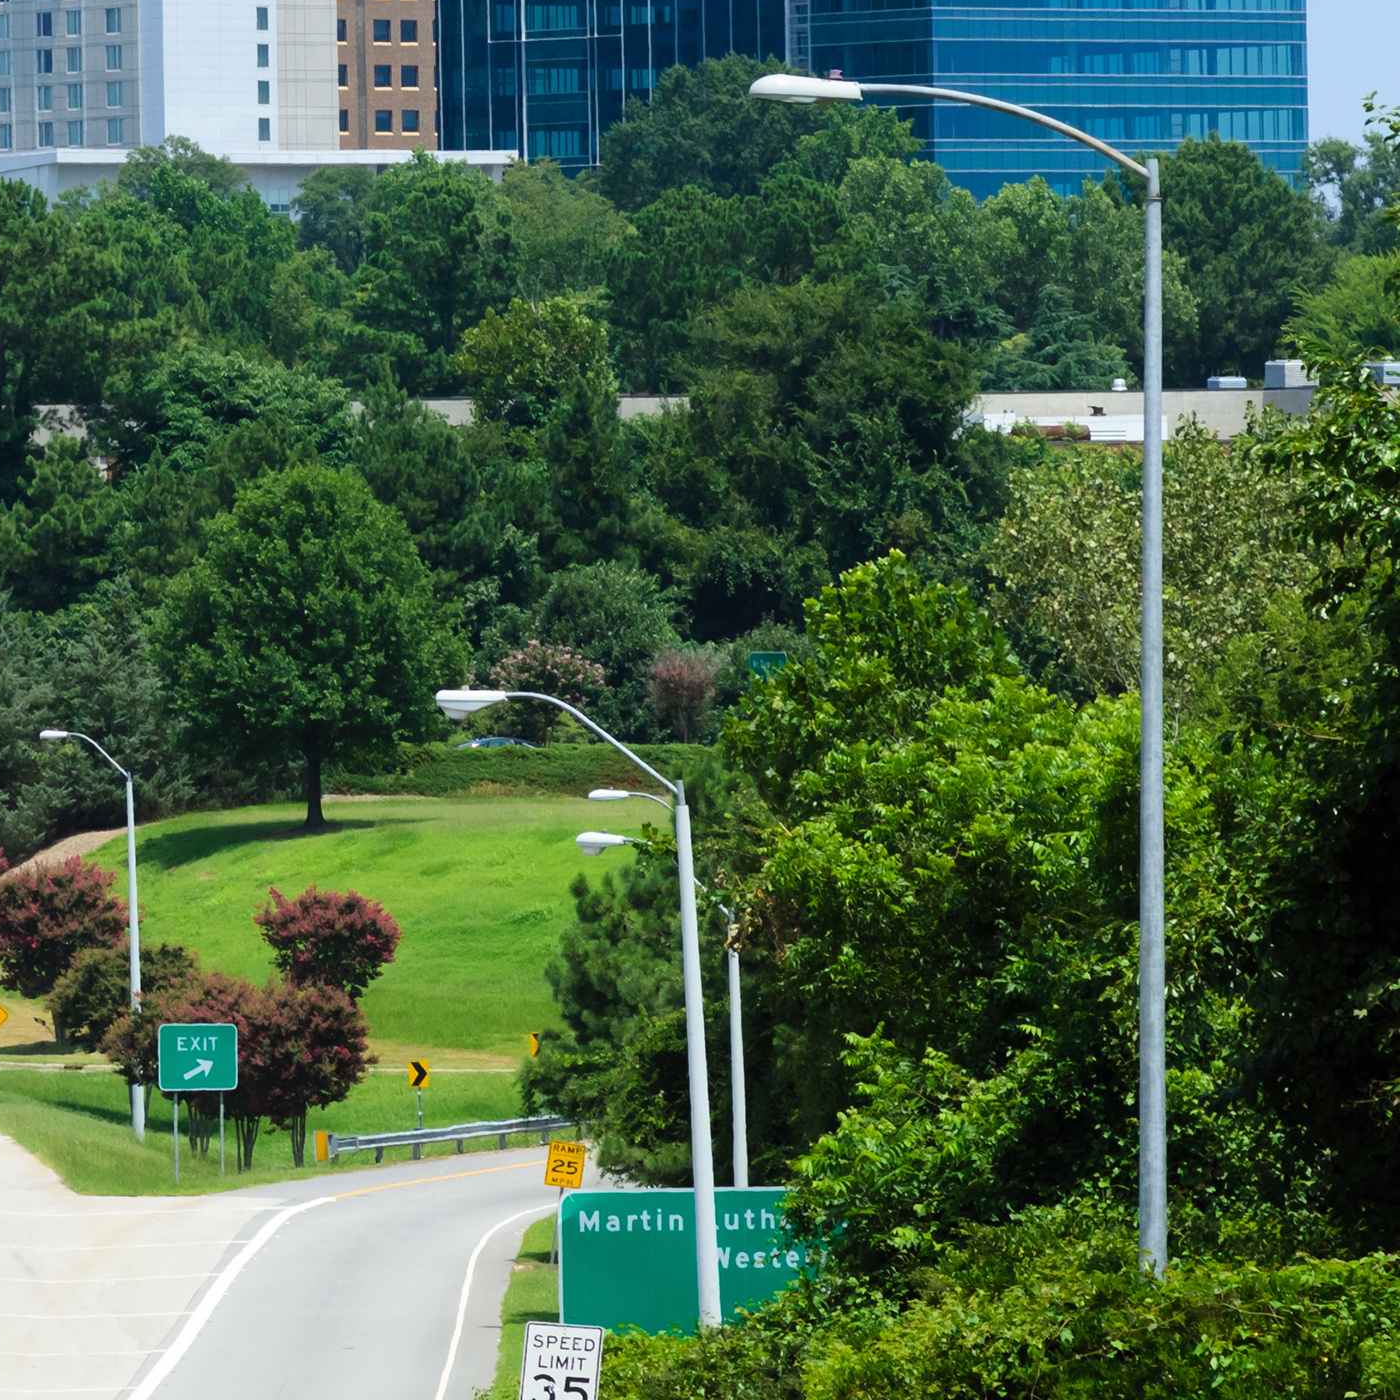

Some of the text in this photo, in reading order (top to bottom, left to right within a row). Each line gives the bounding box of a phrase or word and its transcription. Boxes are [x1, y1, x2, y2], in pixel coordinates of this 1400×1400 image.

[176, 1036, 218, 1052] EXIT
[553, 1144, 583, 1154] RAMP
[551, 1159, 578, 1175] 25
[579, 1207, 792, 1232] Martin uth
[717, 1246, 828, 1269] Weste
[533, 1334, 595, 1352] SPEED
[538, 1354, 587, 1371] LIMIT
[531, 1373, 590, 1400] 35
